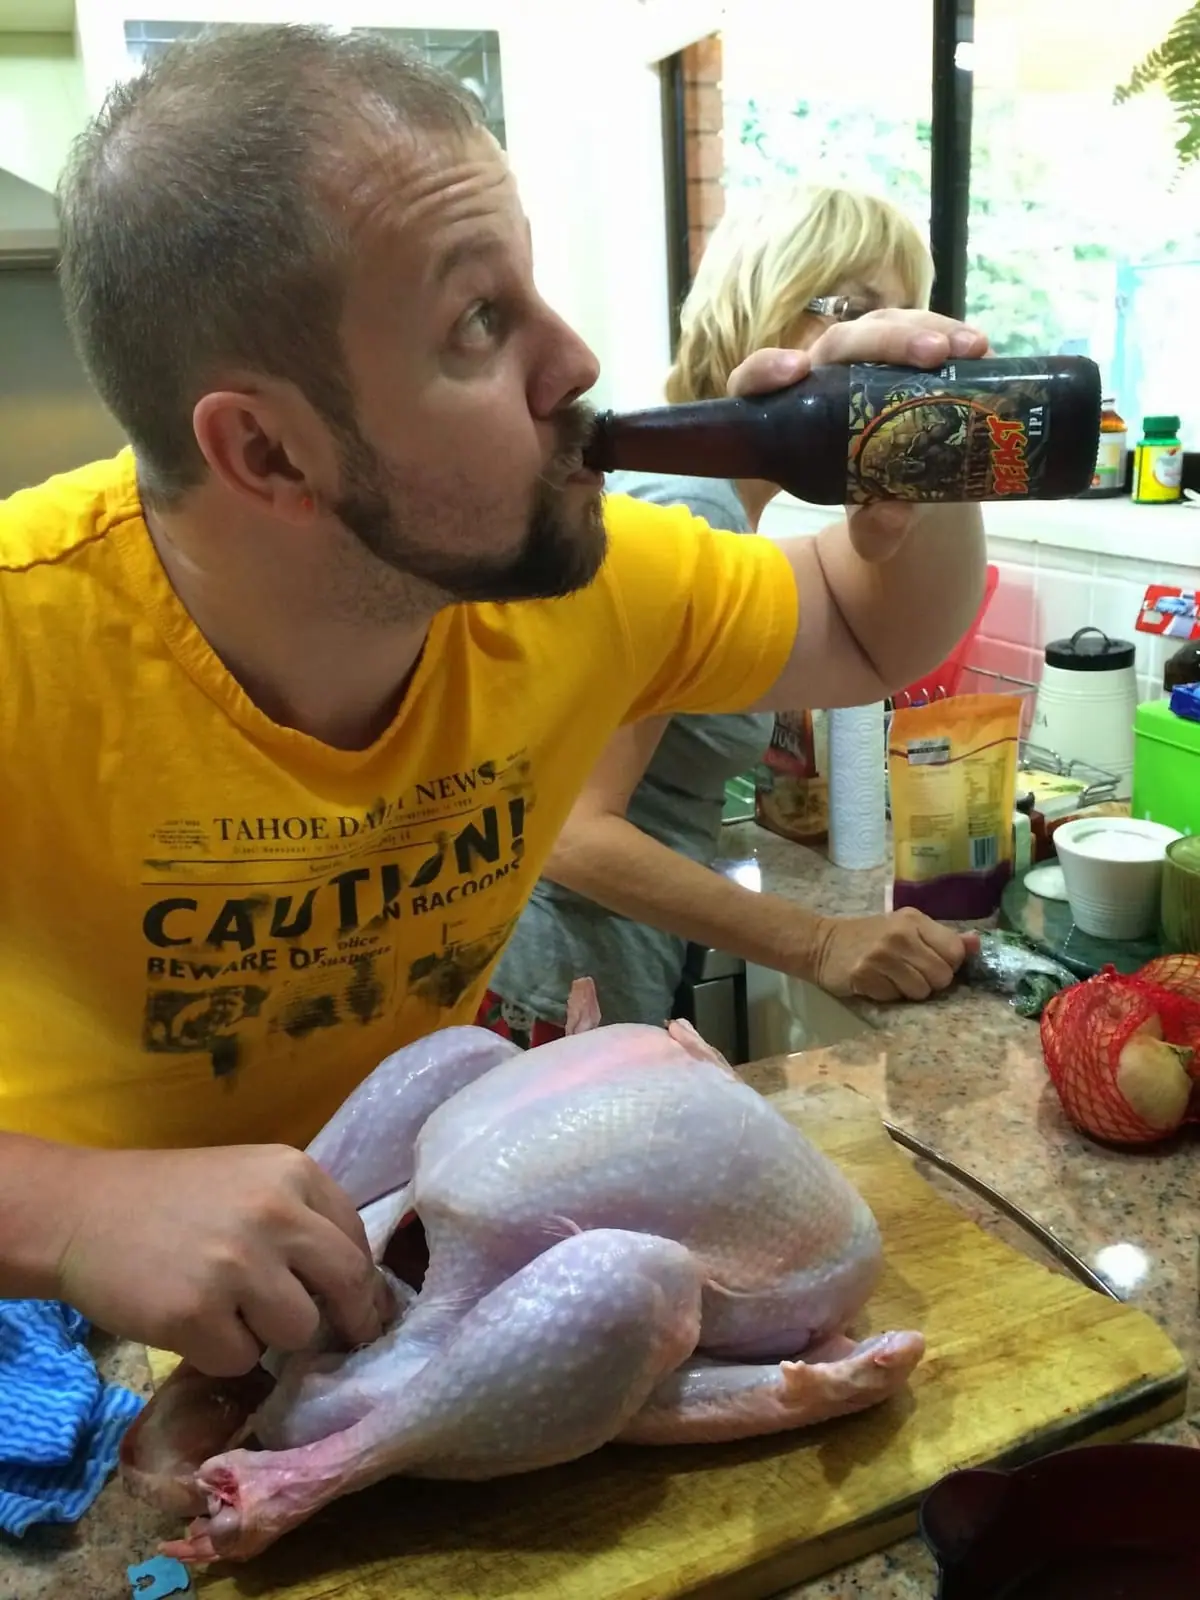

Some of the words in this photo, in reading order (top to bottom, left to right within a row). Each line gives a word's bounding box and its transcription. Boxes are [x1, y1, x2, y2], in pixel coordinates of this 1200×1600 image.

[1029, 406, 1043, 436] IPA
[986, 415, 1029, 495] BEAST
[213, 816, 330, 841] TAHOE
[147, 948, 277, 980] BEWARE
[289, 946, 327, 970] OF
